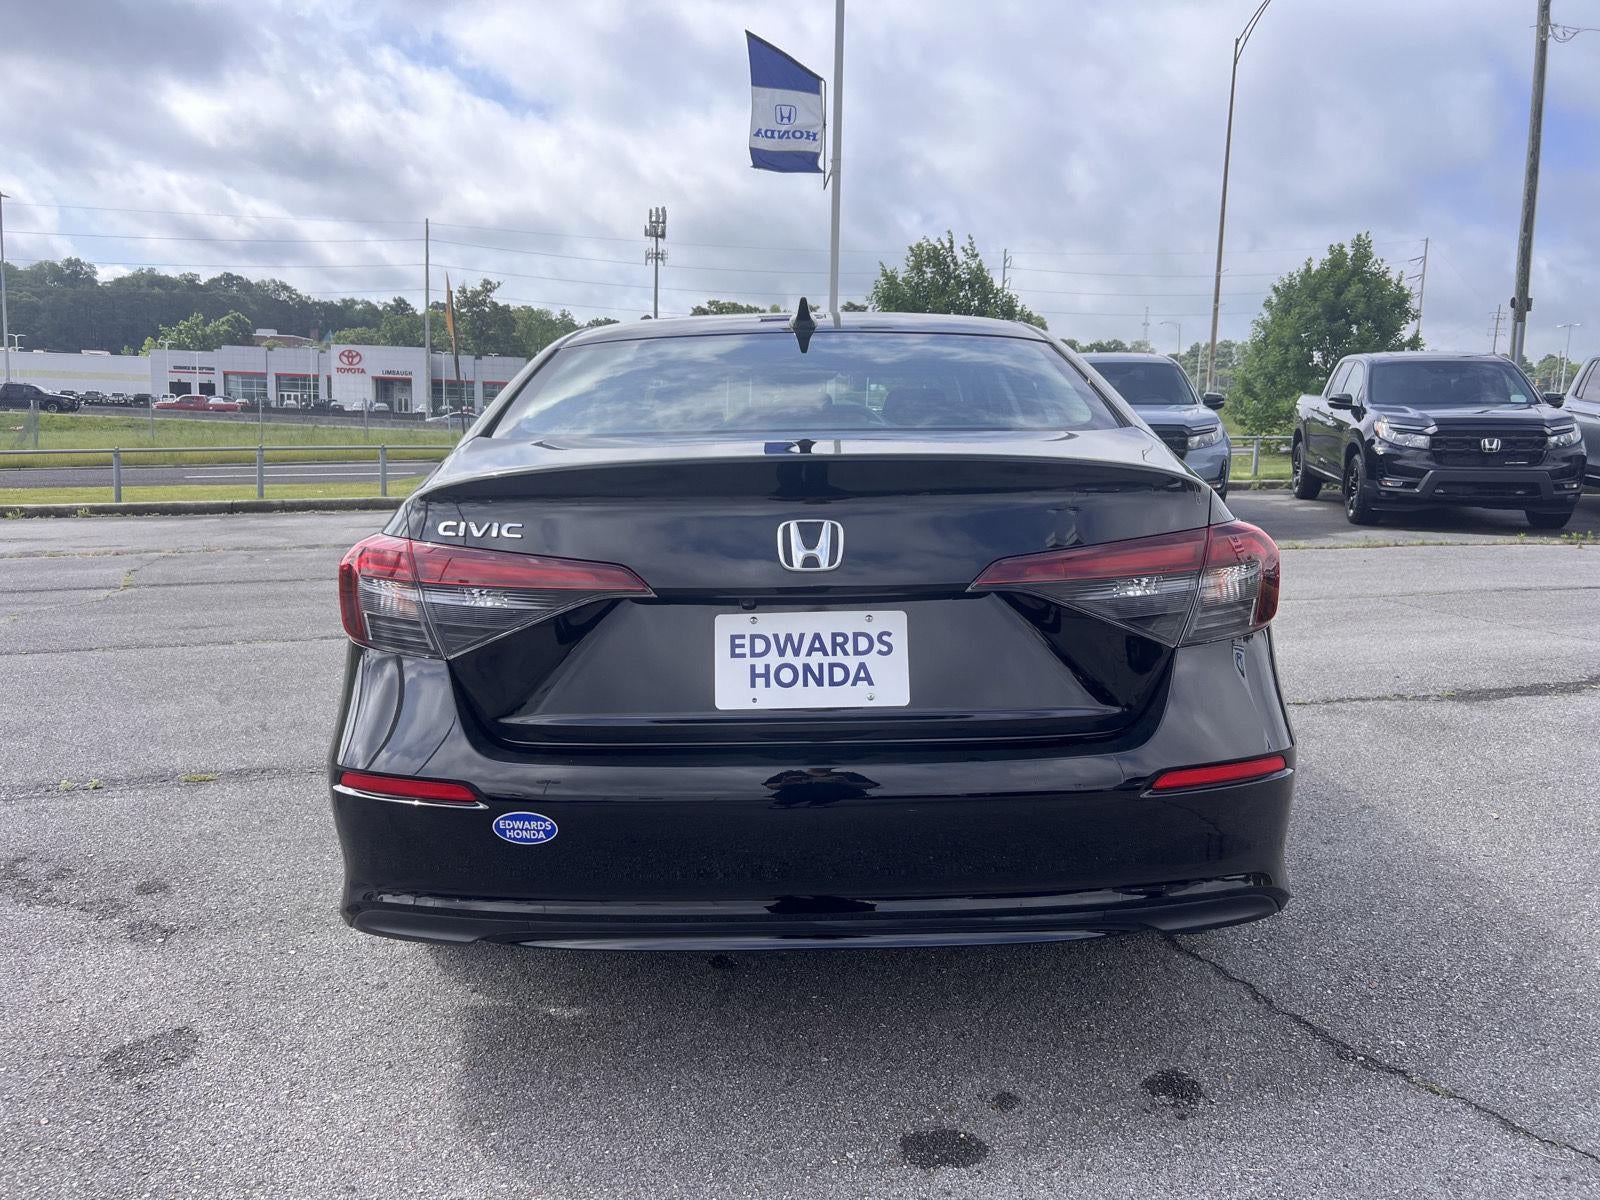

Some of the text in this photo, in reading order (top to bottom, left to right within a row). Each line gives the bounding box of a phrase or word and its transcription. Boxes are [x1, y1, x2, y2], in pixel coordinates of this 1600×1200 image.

[336, 367, 366, 375] TOYOTA
[437, 520, 524, 538] CIVIC
[729, 630, 894, 659] EDWARDS
[749, 661, 875, 689] HONDA
[499, 820, 552, 831] EDWARDS
[506, 829, 546, 839] HONDA
